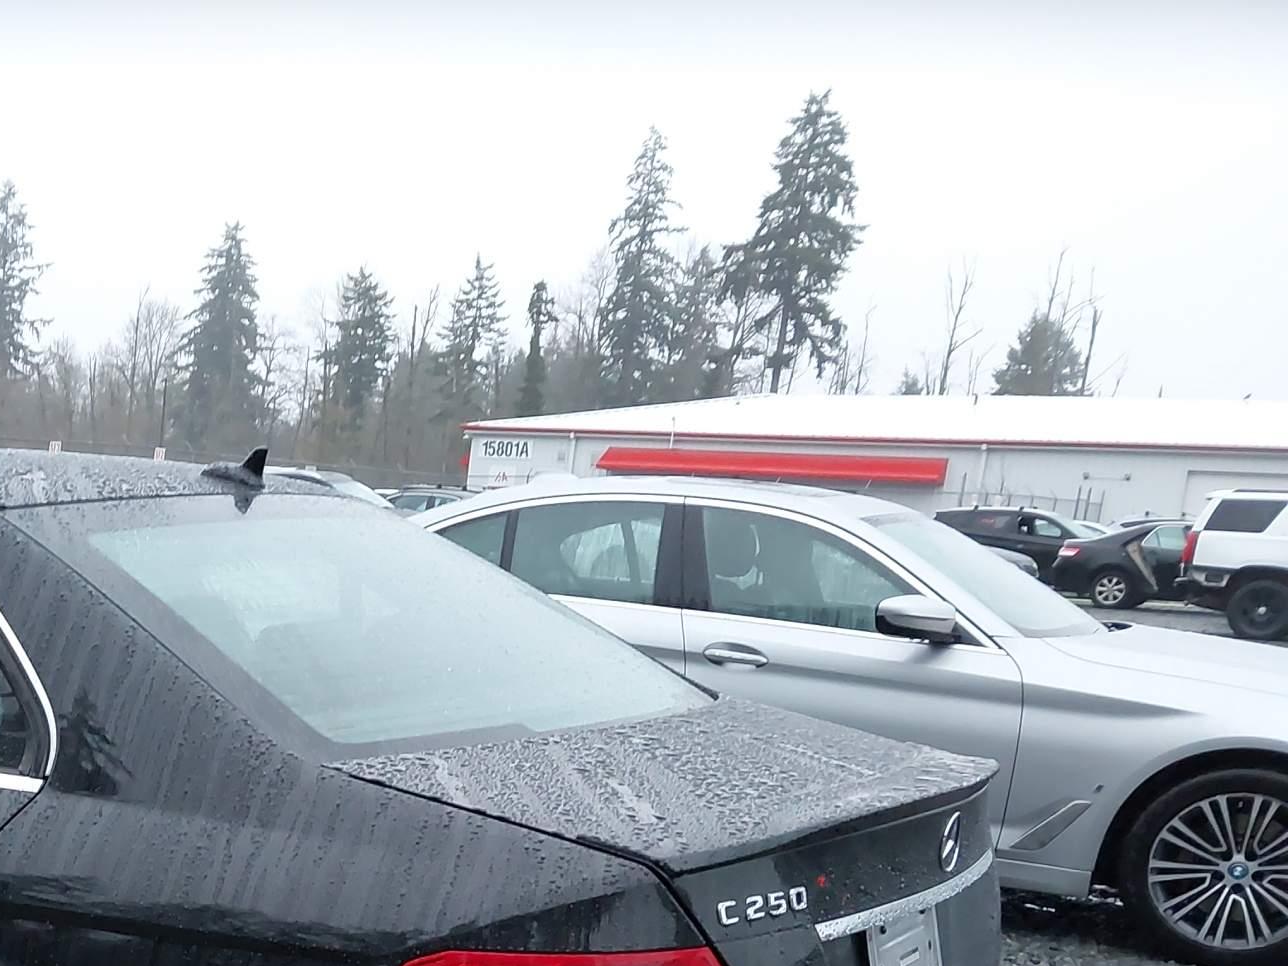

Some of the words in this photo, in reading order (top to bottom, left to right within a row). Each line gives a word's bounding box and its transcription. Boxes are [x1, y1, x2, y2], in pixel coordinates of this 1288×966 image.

[482, 440, 529, 458] 15801A
[717, 900, 740, 926] C
[745, 886, 808, 921] 250
